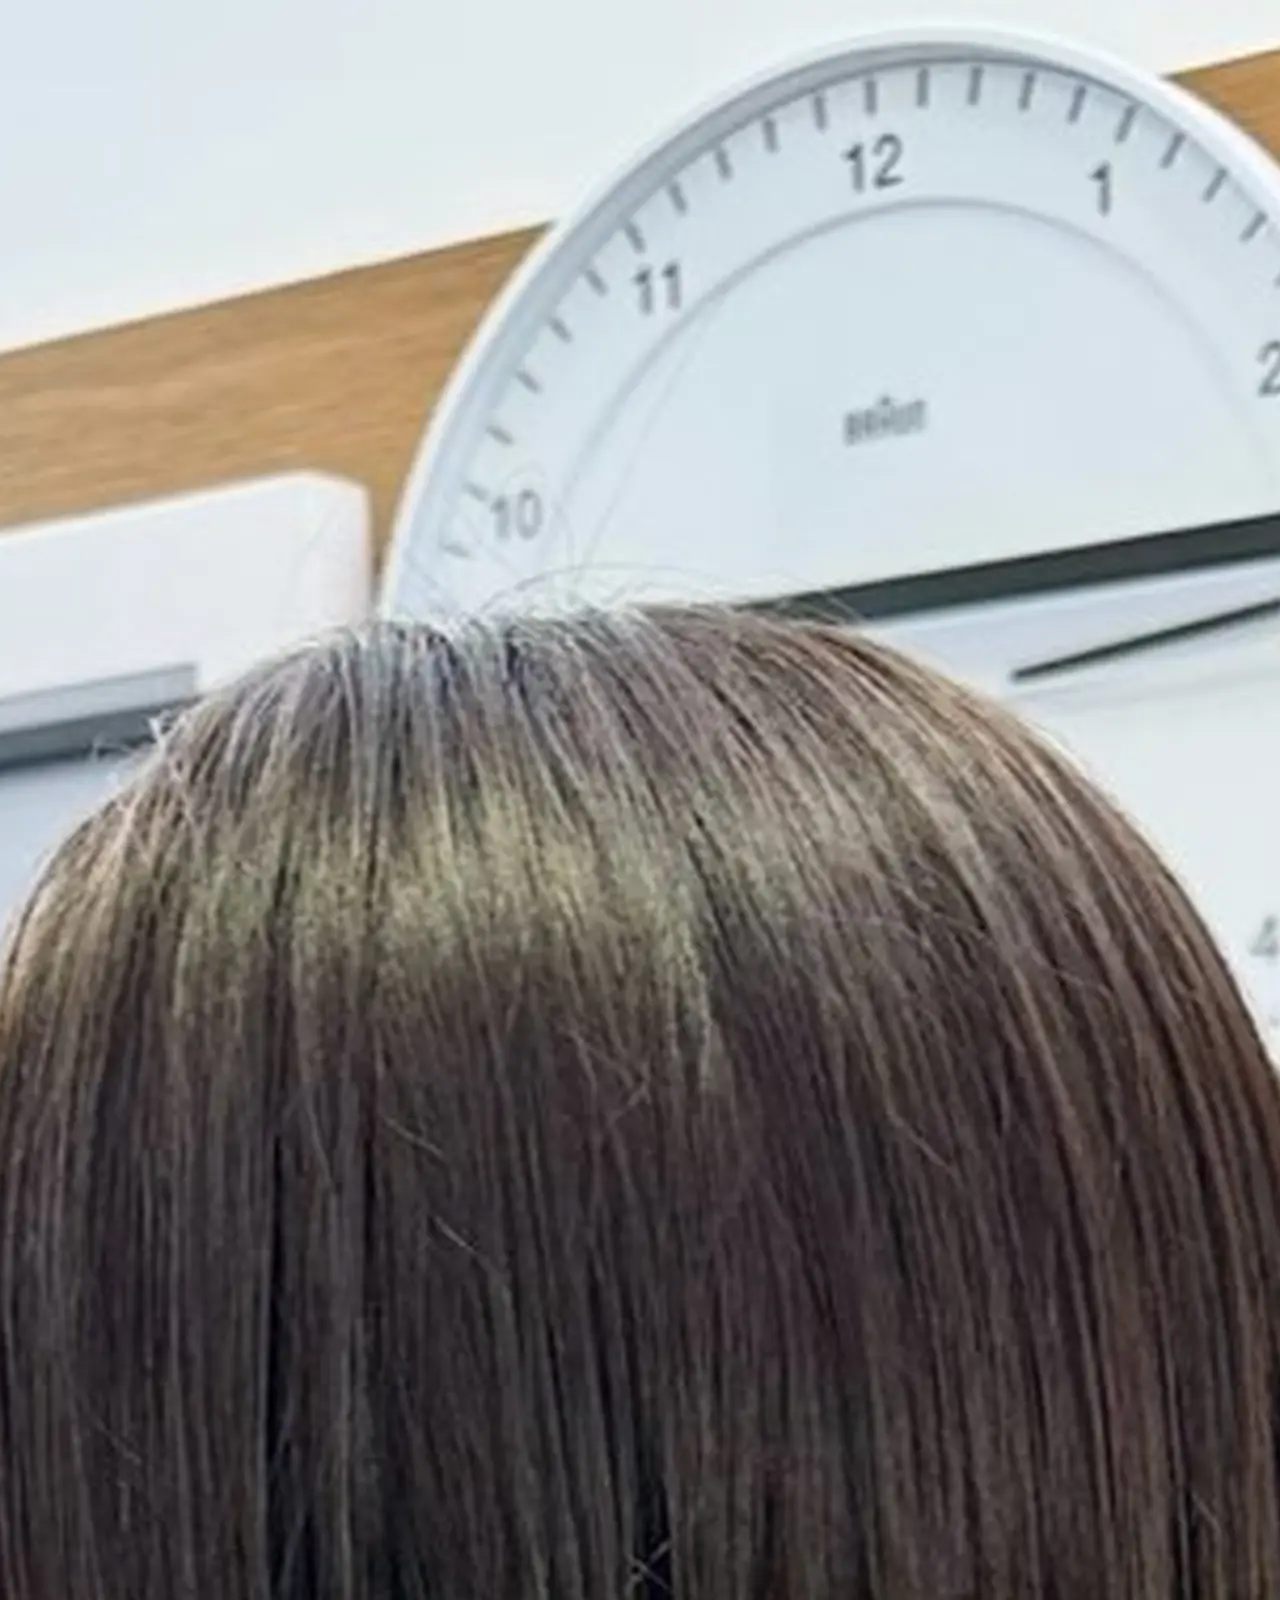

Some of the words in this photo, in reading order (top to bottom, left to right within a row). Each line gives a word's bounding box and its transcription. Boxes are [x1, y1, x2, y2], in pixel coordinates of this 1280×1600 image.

[844, 133, 906, 194] 12
[1088, 162, 1114, 214] 1
[631, 264, 683, 314] 11
[490, 492, 544, 541] 10
